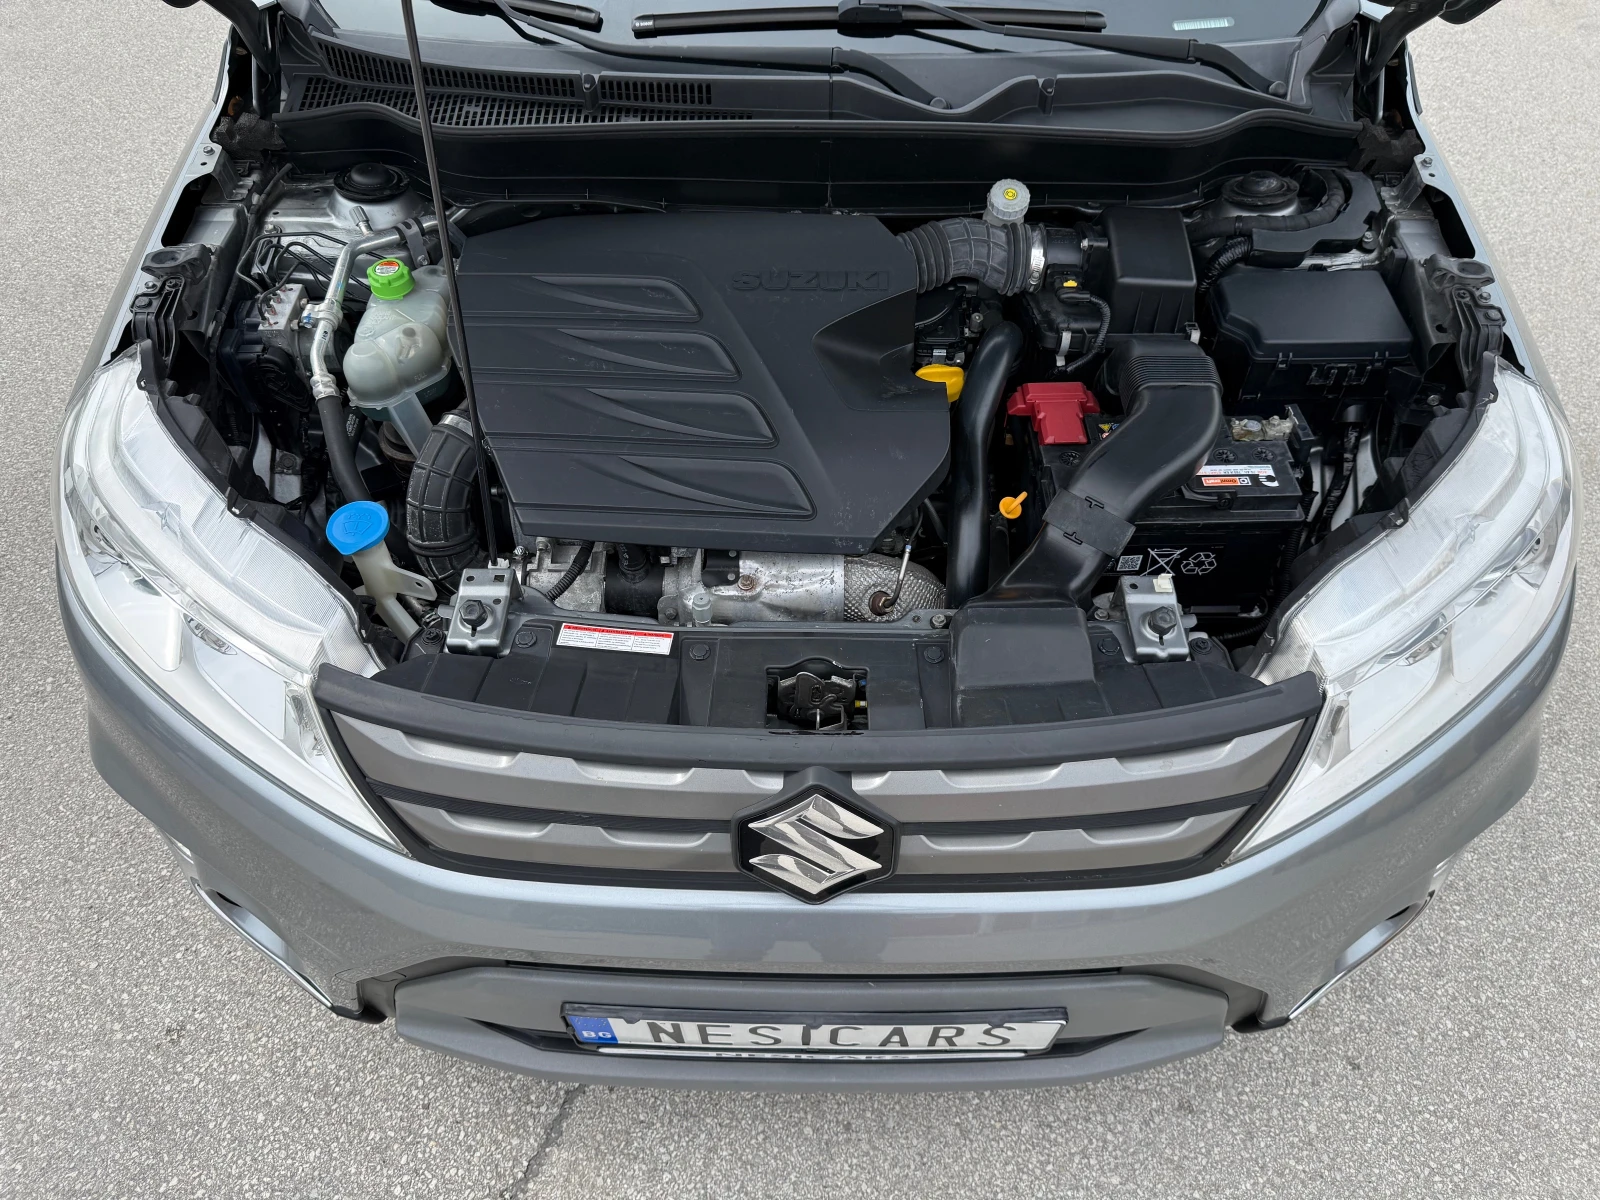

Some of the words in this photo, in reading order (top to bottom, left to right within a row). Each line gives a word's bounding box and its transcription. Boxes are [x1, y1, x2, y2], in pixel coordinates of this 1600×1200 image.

[732, 270, 890, 292] SUZUKI
[582, 1030, 612, 1039] BG
[646, 1021, 1017, 1047] NESICARS
